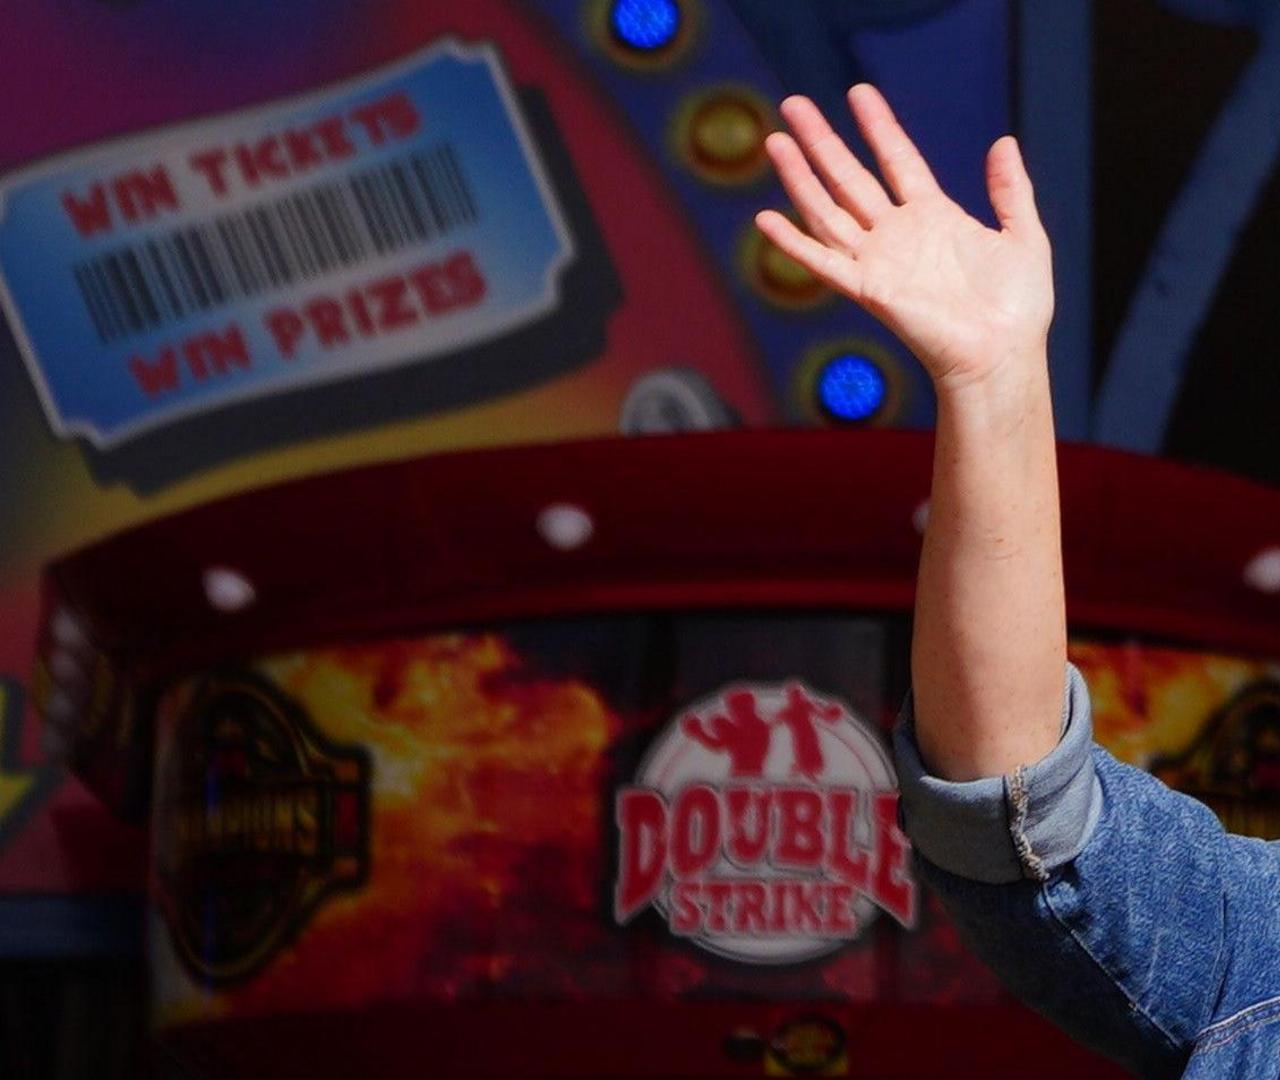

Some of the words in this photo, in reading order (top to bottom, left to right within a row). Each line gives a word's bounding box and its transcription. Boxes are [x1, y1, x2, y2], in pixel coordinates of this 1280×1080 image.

[59, 164, 181, 238] WIN
[190, 90, 423, 199] TICKETS
[128, 323, 254, 399] WIN
[264, 249, 489, 360] PRIZES
[619, 785, 914, 926] DOUBLE
[673, 881, 858, 932] STRIKE
